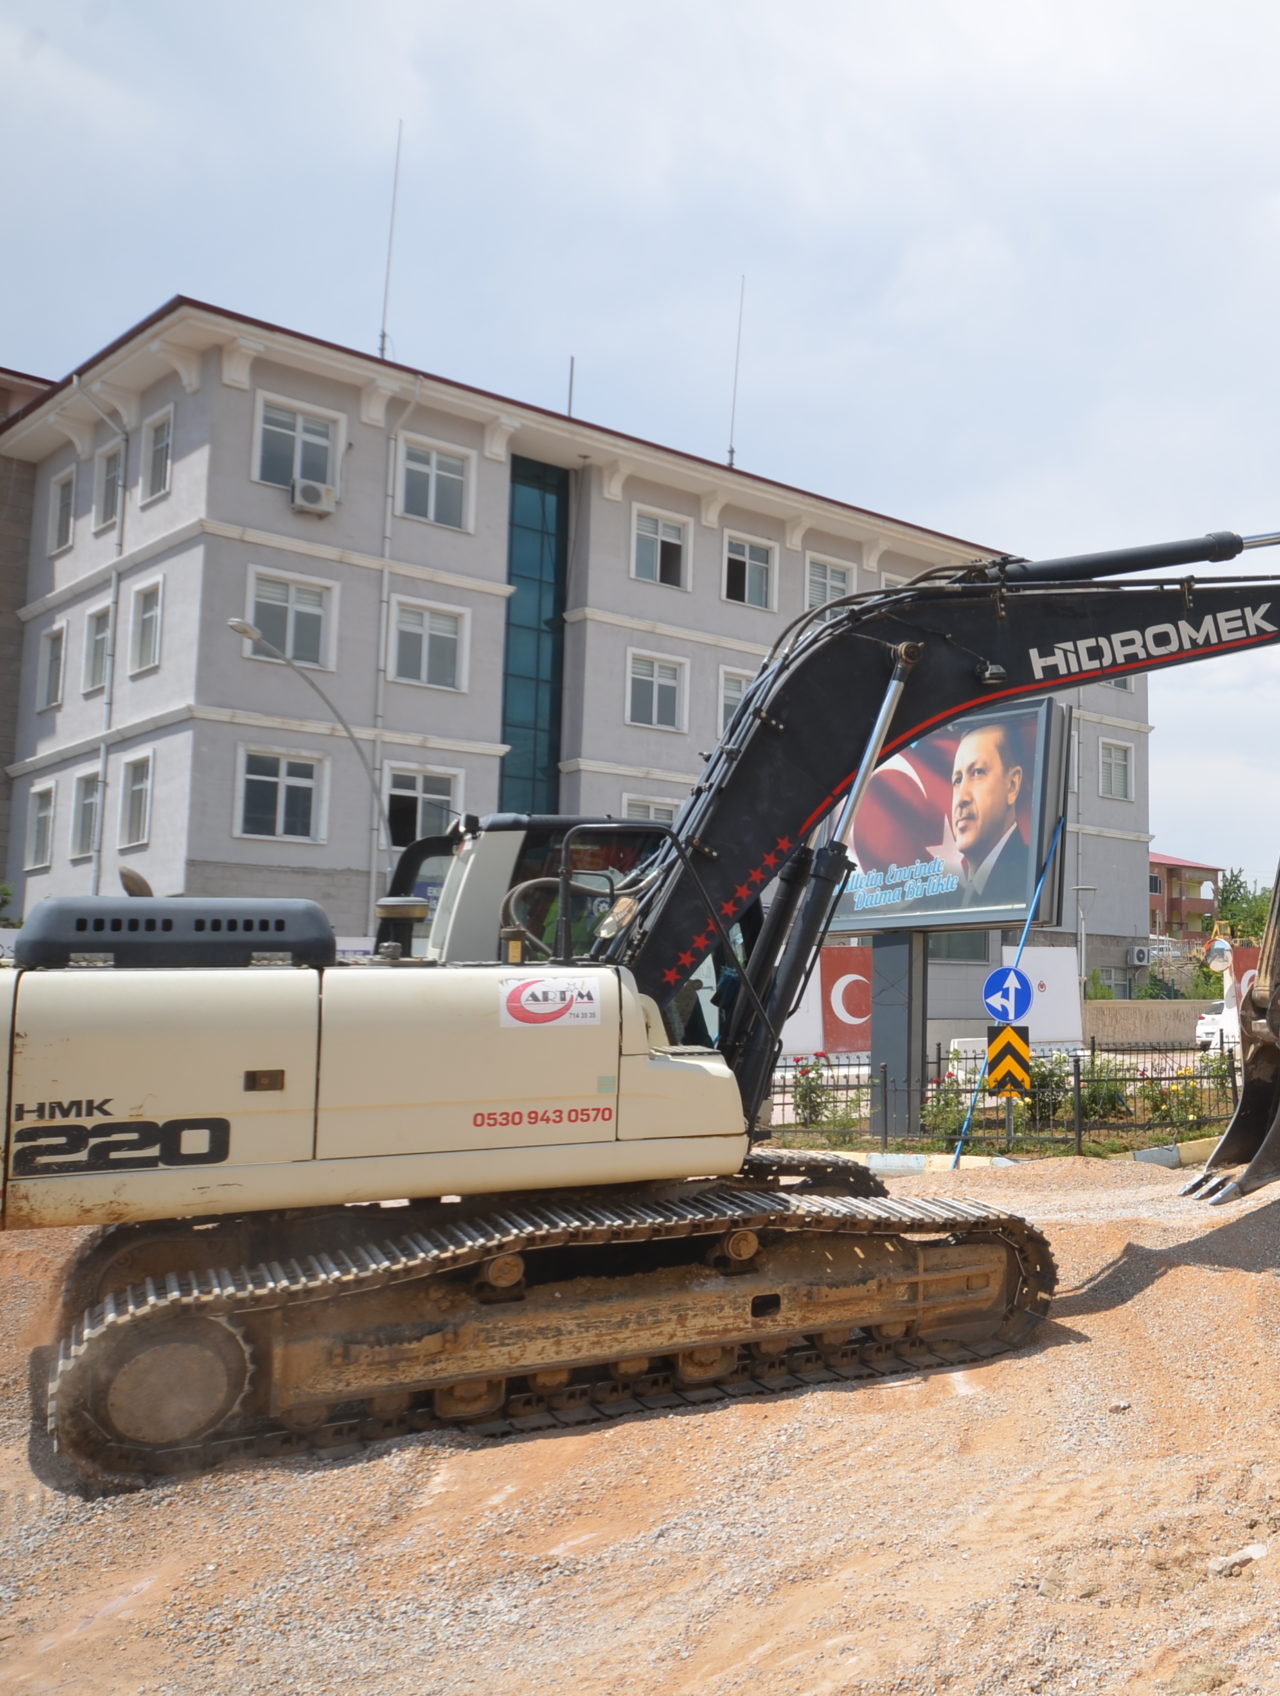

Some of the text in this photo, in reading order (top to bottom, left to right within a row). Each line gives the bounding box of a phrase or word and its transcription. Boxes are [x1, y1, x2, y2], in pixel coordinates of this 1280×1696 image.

[885, 856, 945, 885] Emrinde
[854, 873, 959, 911] Daima Birlikte
[14, 1098, 114, 1122] HMK
[472, 1107, 613, 1128] 0530 943 0570
[13, 1117, 231, 1176] 220
